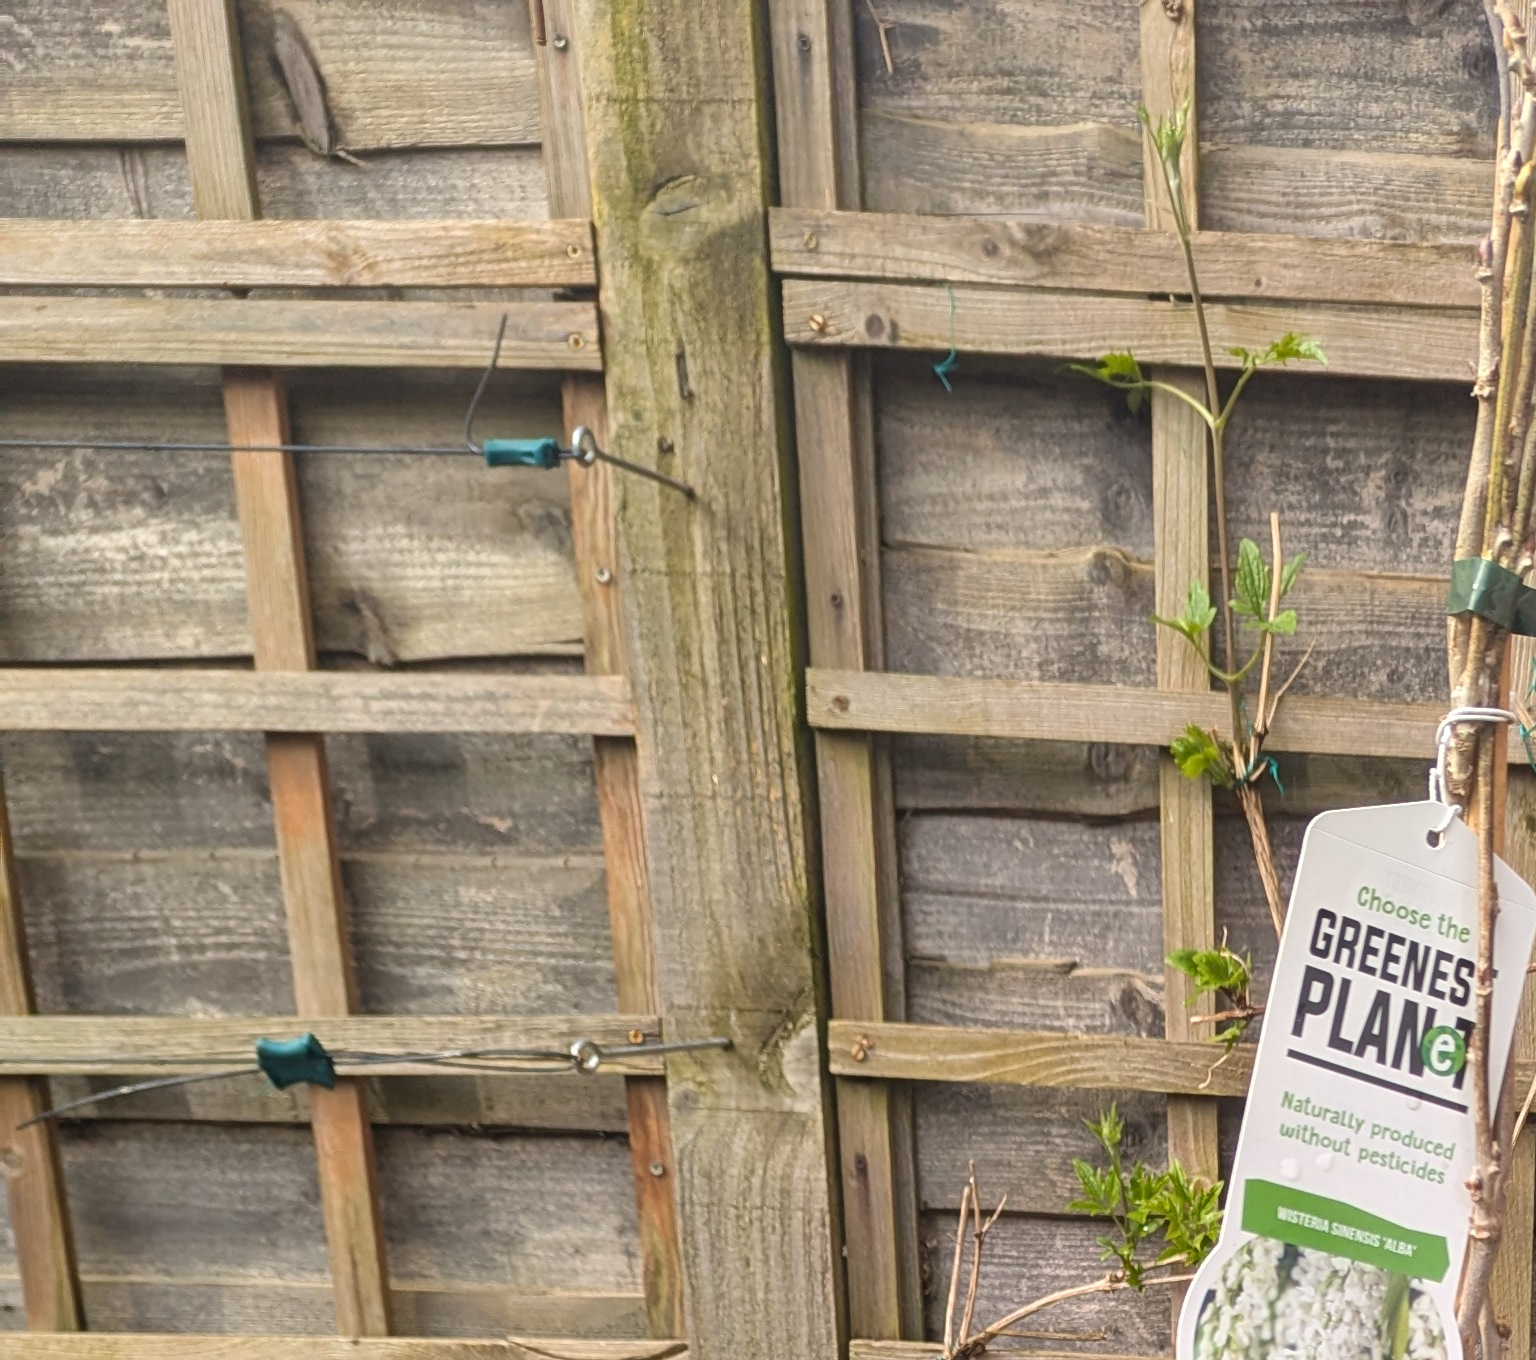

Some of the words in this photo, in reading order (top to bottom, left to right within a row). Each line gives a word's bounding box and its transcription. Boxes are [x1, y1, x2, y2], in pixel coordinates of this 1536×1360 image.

[1357, 886, 1432, 929] Choose
[1437, 914, 1471, 943] the
[1309, 908, 1498, 1007] GREENES
[1279, 1123, 1351, 1156] without
[1357, 1147, 1446, 1184] pesticides
[1280, 1091, 1365, 1134] Naturally
[1370, 1123, 1456, 1161] produced
[1277, 1206, 1329, 1234] WISTERIA
[1331, 1222, 1381, 1248] SINENSIS
